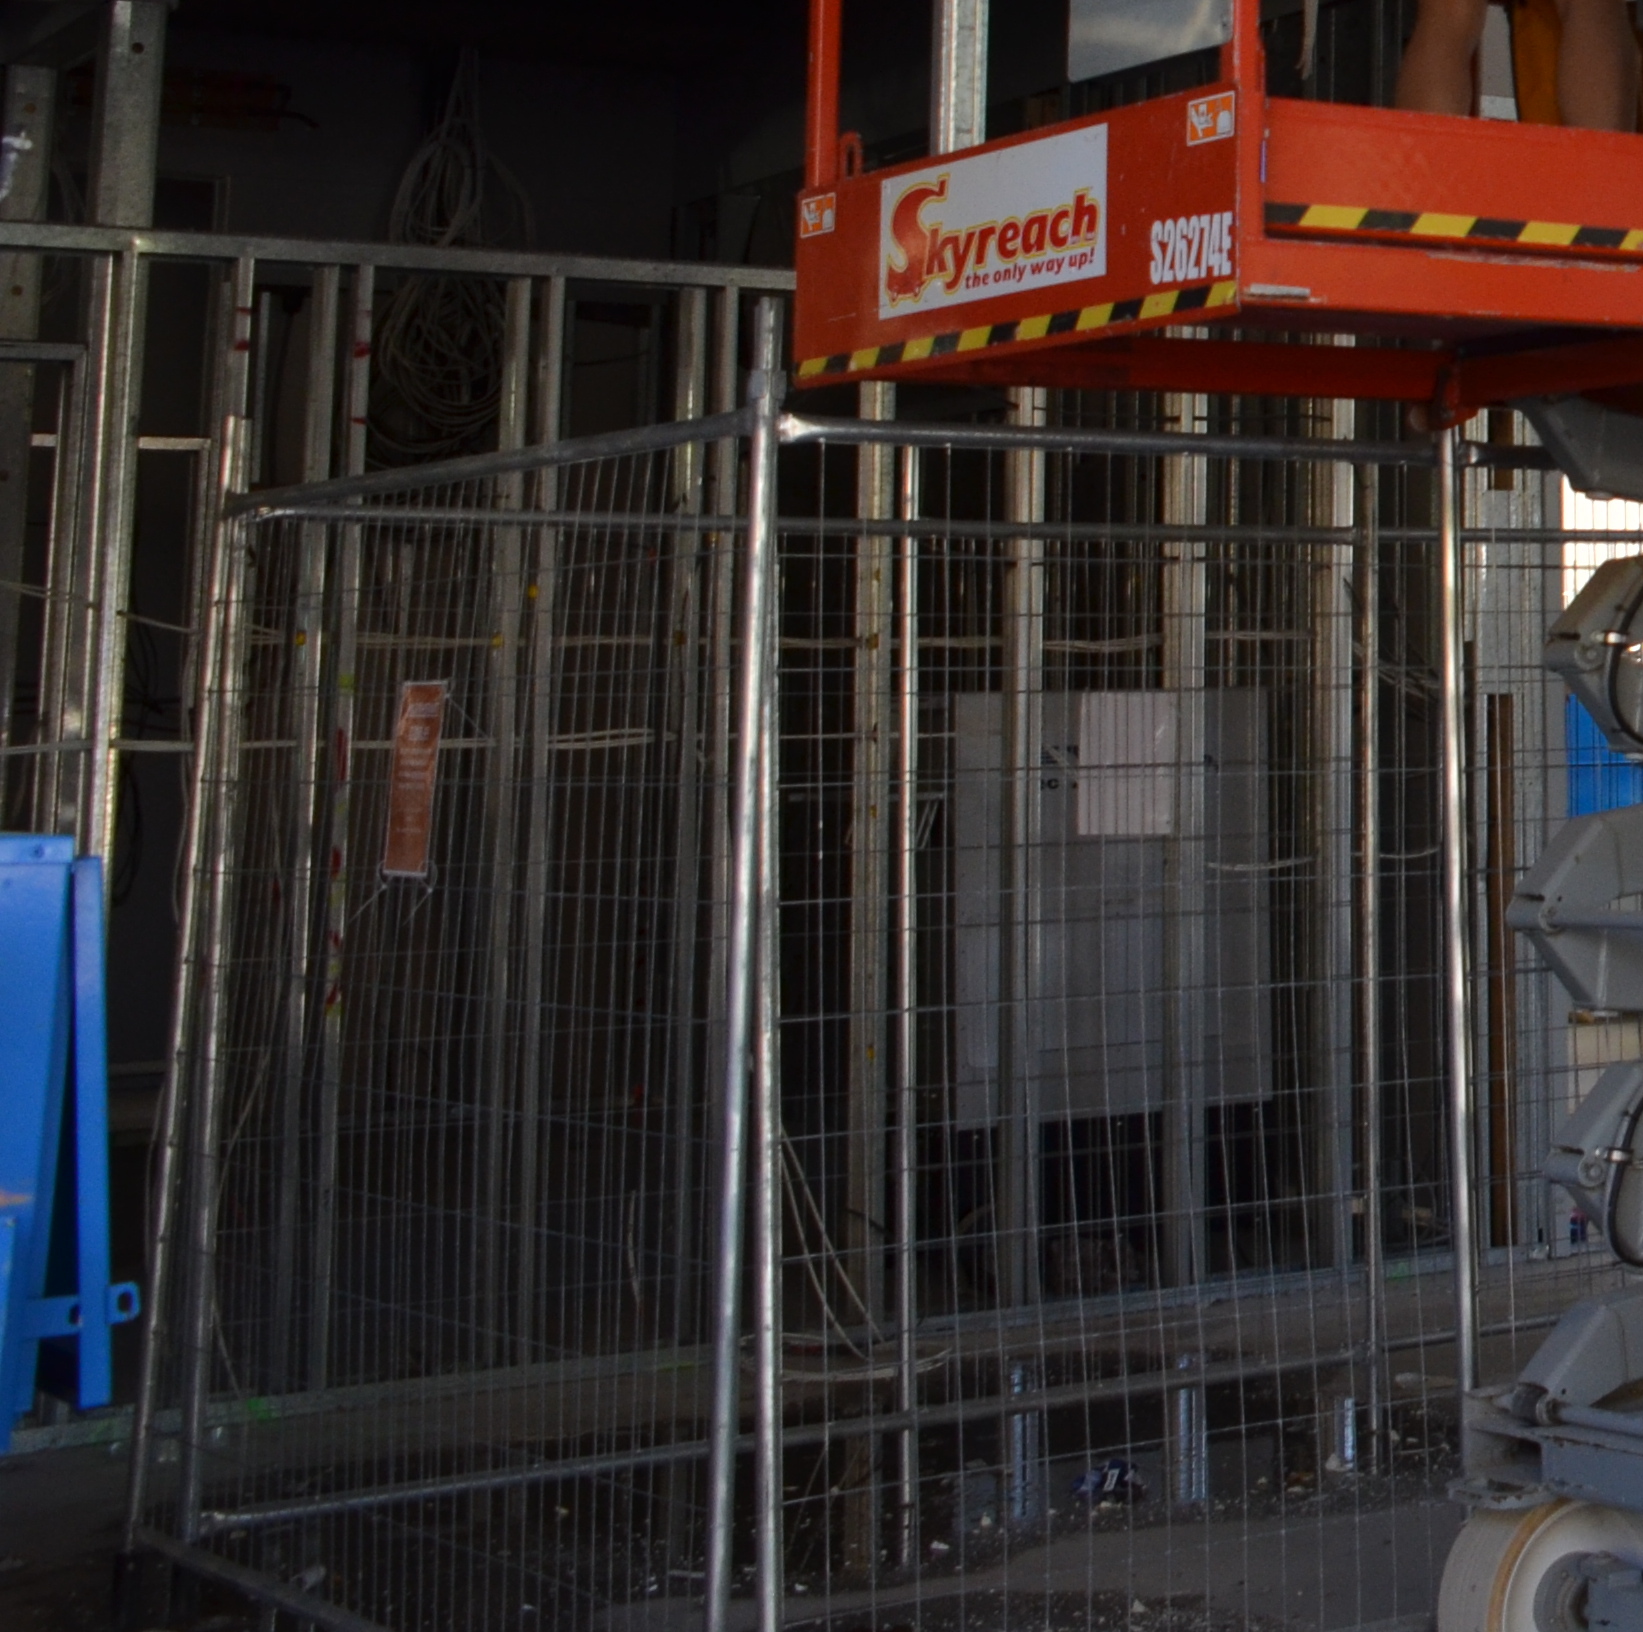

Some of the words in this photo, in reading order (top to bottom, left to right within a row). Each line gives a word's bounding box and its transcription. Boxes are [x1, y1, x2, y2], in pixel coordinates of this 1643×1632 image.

[886, 175, 1099, 306] Skyreach
[965, 272, 989, 289] the
[993, 263, 1027, 283] only
[1030, 256, 1066, 276] way
[1068, 246, 1095, 270] up!
[1150, 211, 1233, 285] S26274E
